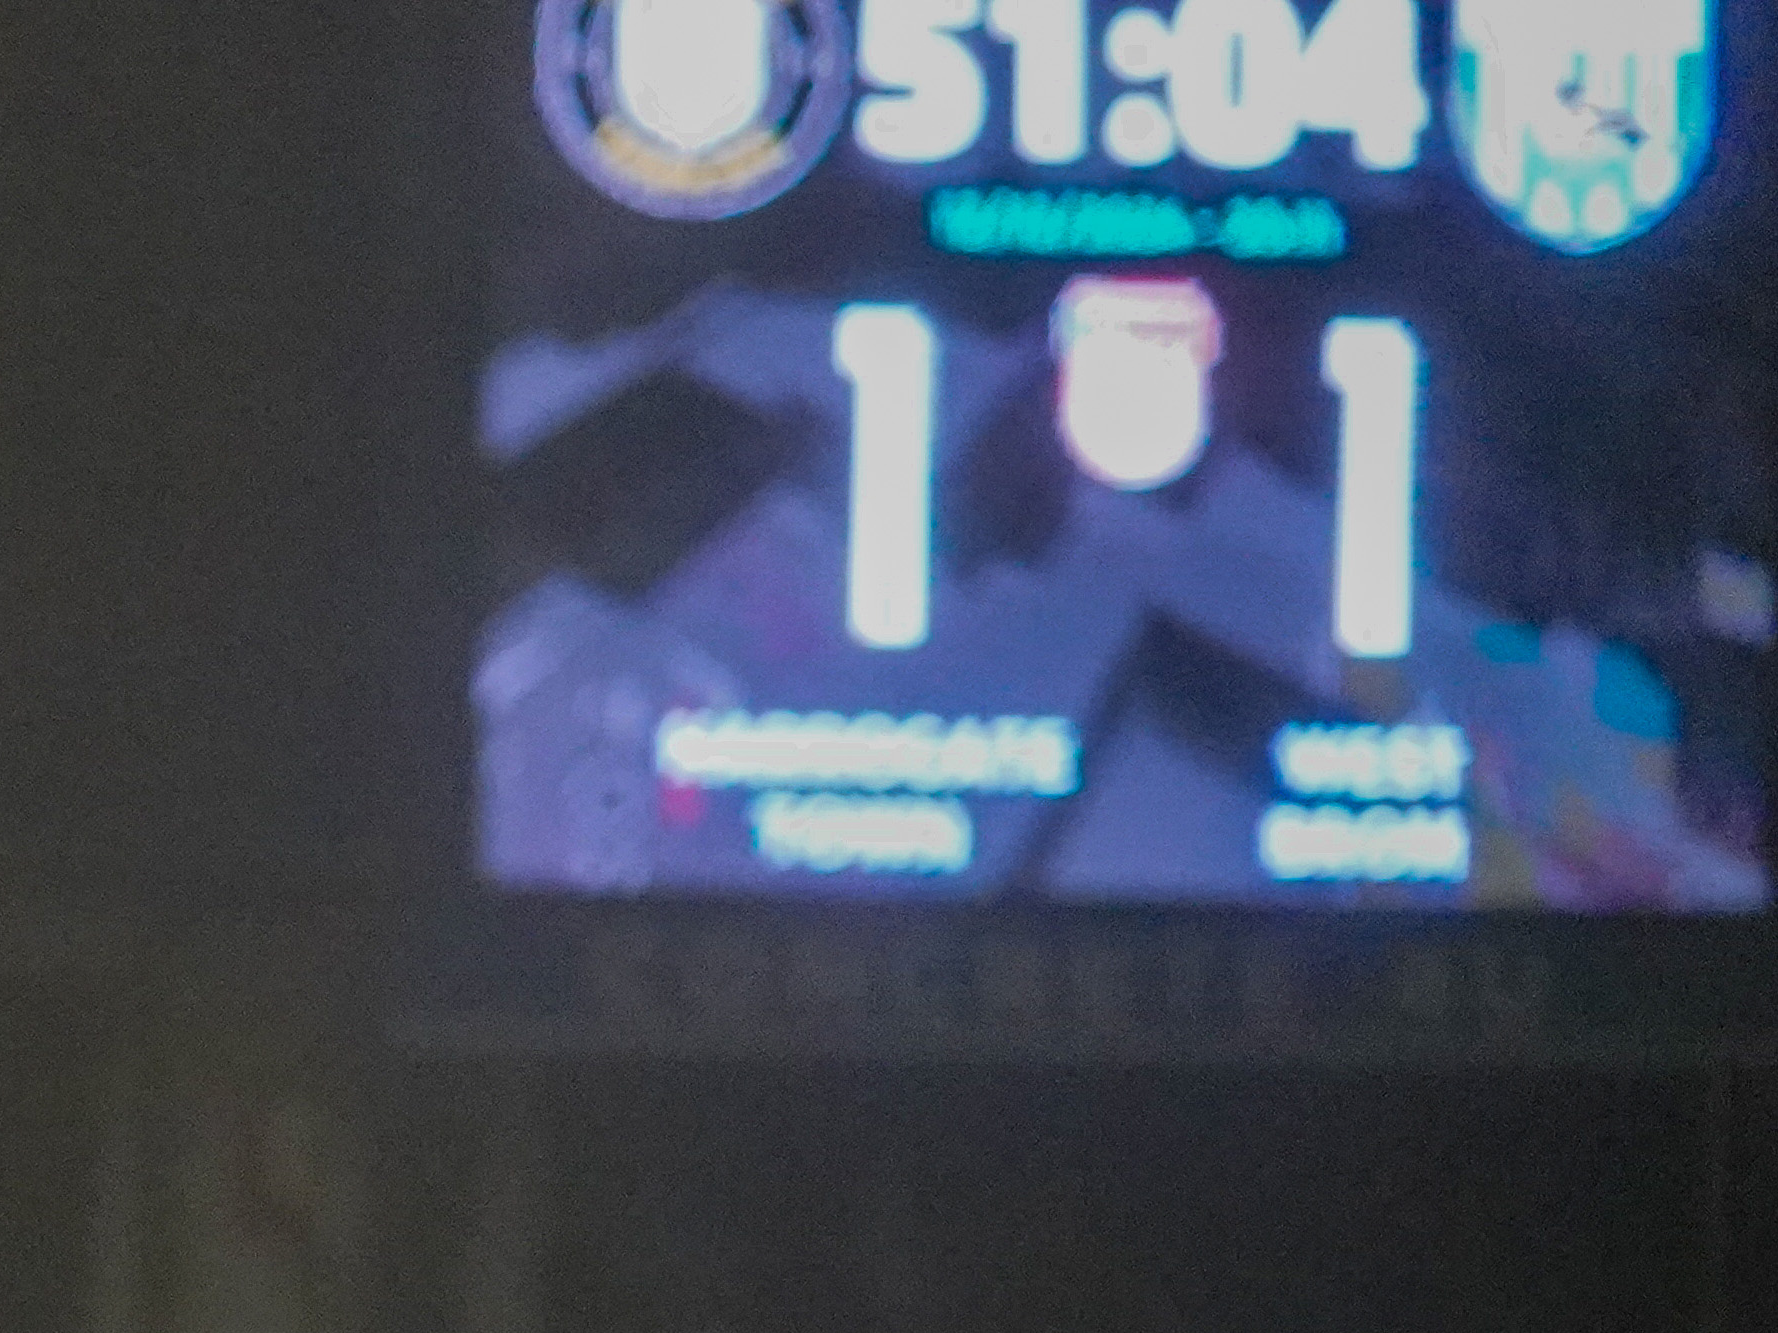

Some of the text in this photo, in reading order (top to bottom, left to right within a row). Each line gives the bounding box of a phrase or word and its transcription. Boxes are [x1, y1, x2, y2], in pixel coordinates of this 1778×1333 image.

[852, 0, 1432, 170] 51:04
[832, 302, 935, 649] 1
[1321, 315, 1420, 658] 1
